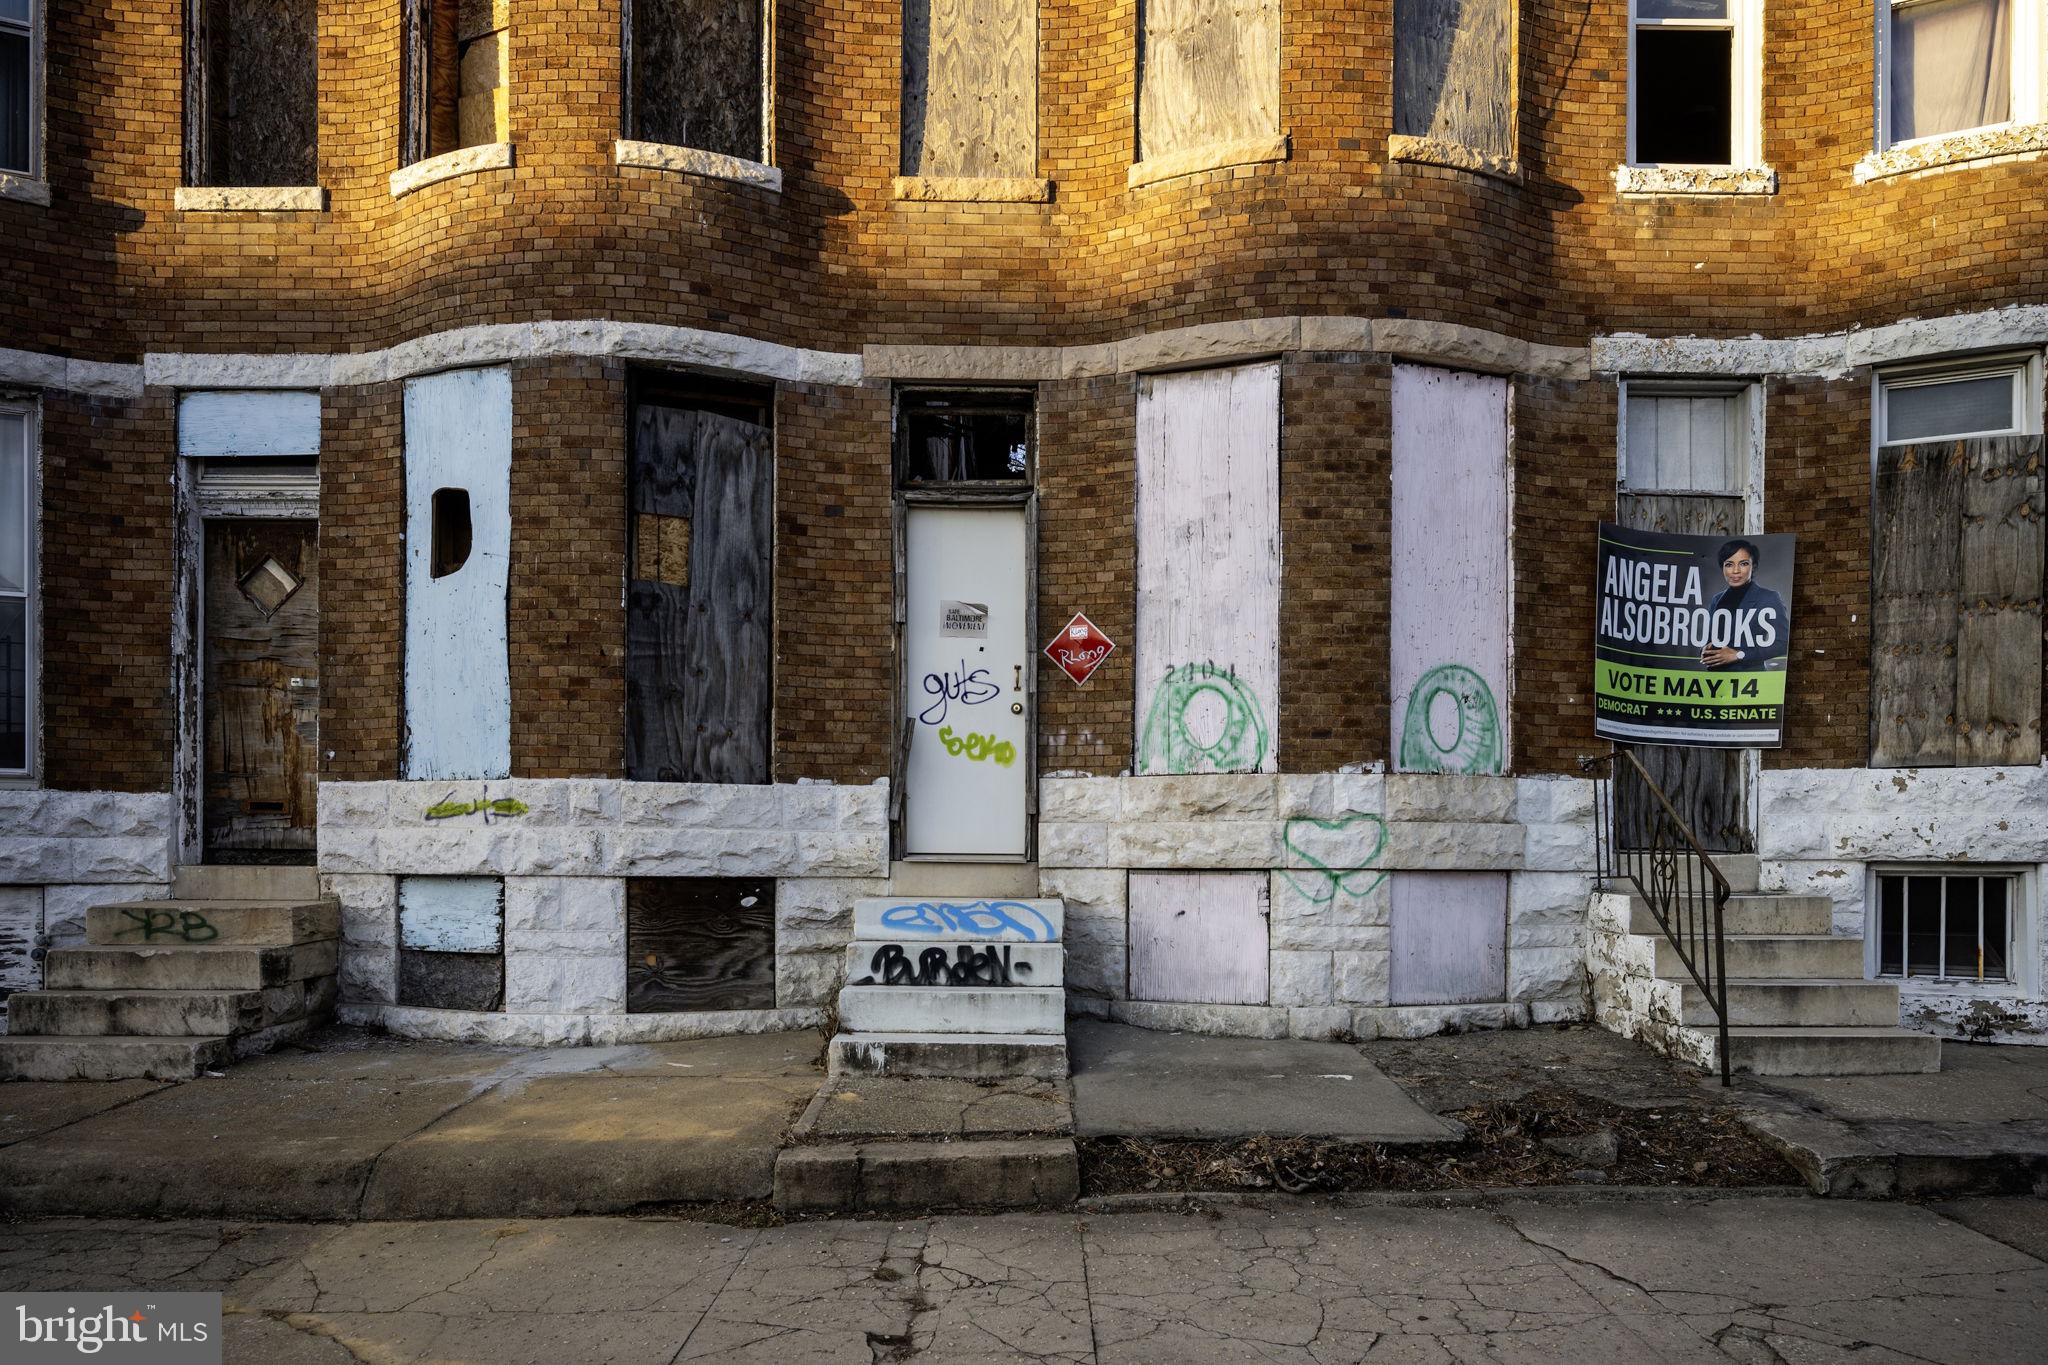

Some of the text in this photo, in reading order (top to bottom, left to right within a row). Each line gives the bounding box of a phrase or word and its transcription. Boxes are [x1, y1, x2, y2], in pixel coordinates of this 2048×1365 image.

[1605, 555, 1703, 605] ANGELA
[946, 614, 983, 623] BALTIMORE
[1600, 597, 1777, 648] ALSOBROOKS
[1608, 669, 1759, 699] VOTE MAY 14
[1598, 697, 1777, 720] DEMOCRAT U.S. SENATE
